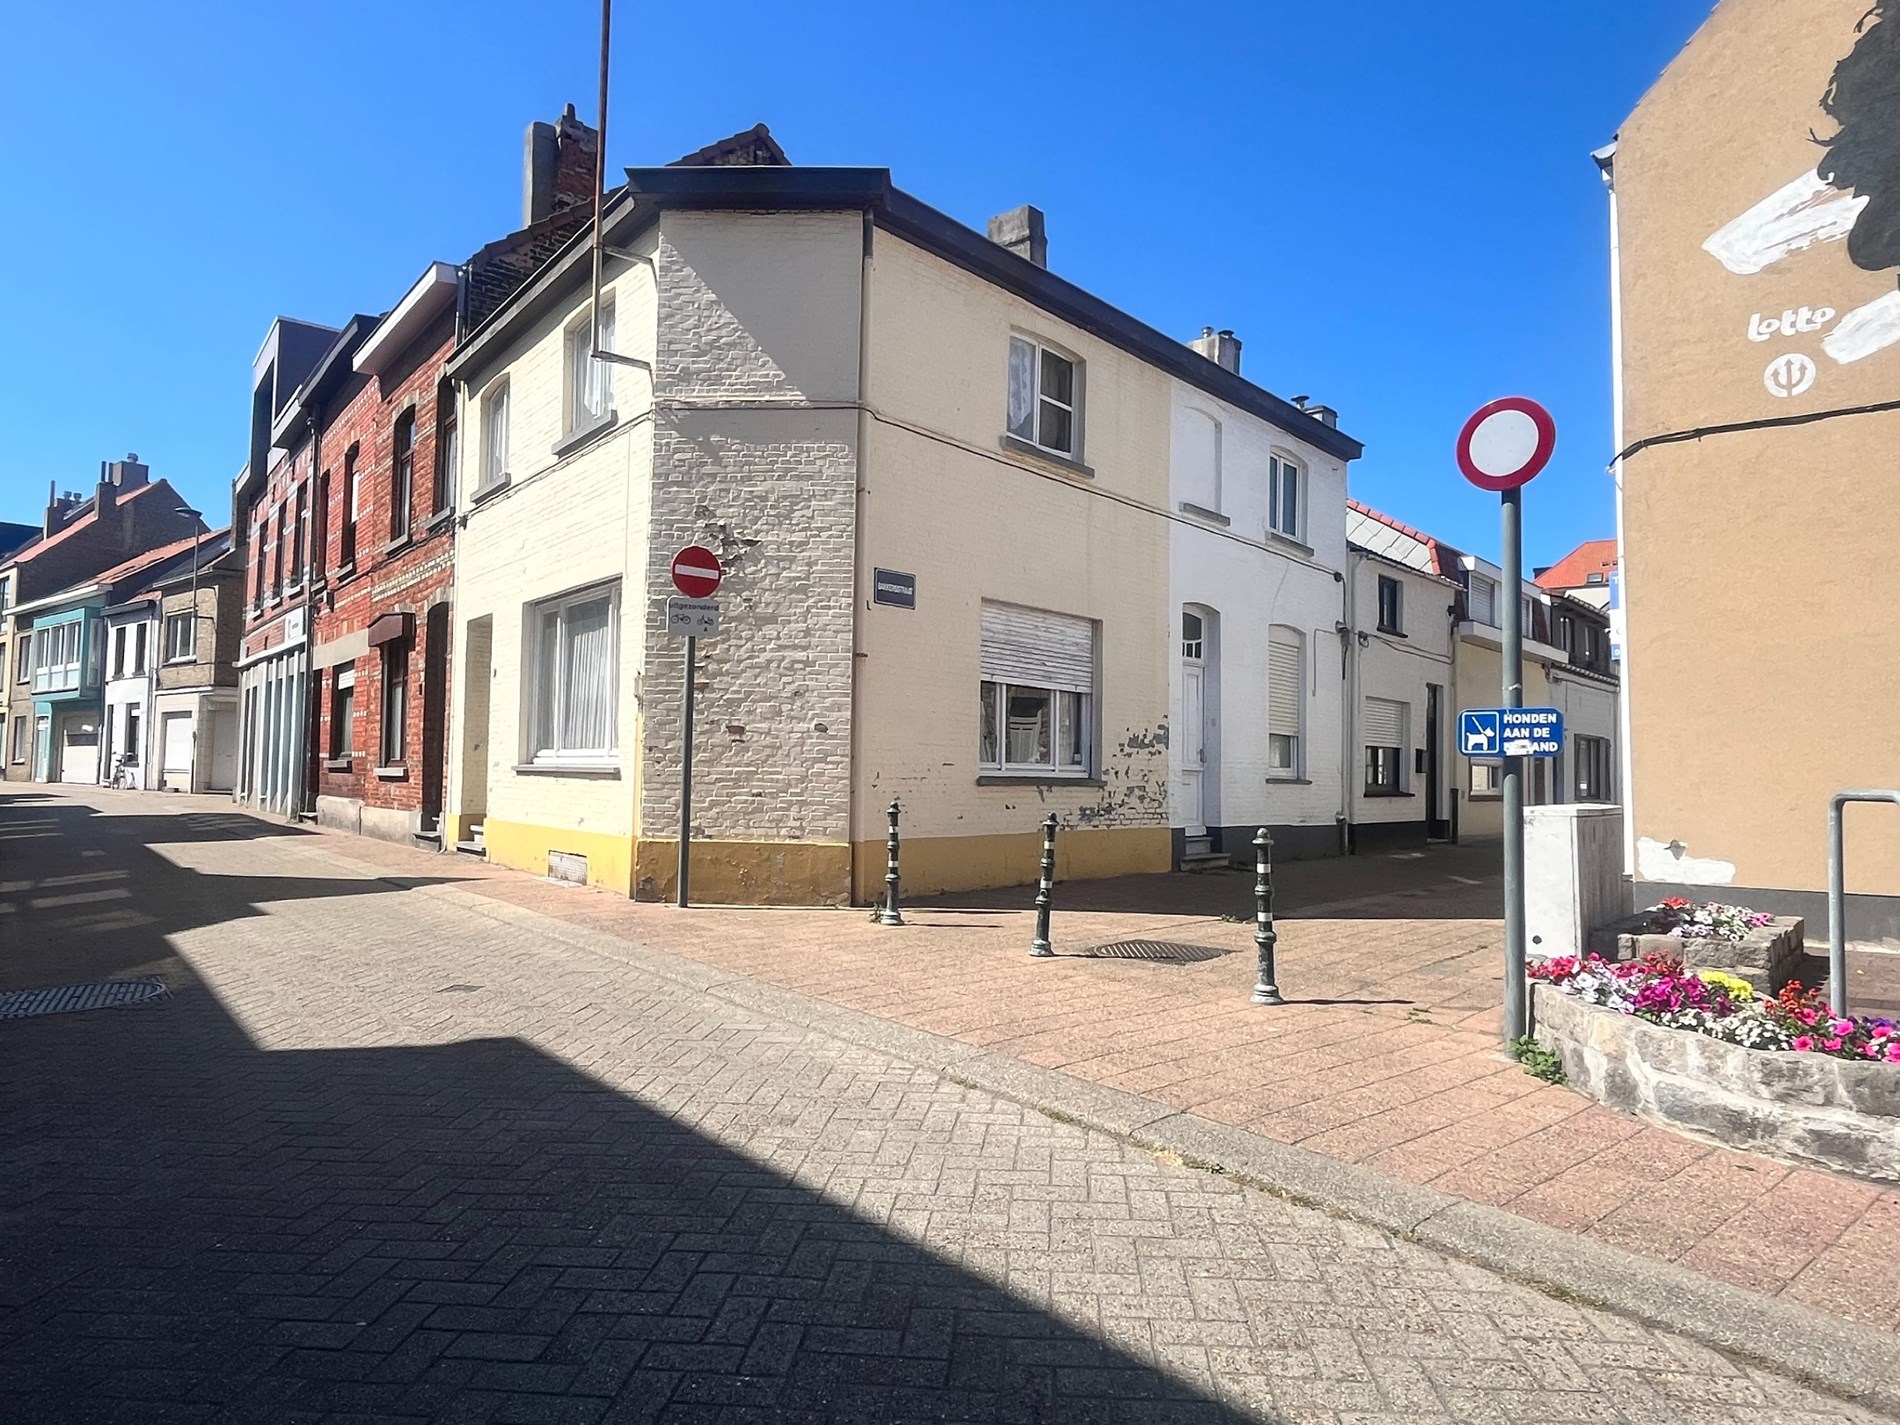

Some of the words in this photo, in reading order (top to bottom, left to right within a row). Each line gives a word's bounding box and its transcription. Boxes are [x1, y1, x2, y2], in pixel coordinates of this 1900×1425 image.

[669, 602, 719, 612] uitgezonderd
[1503, 713, 1557, 724] HONDEN
[1503, 728, 1530, 738] AAN
[1533, 728, 1550, 738] DE
